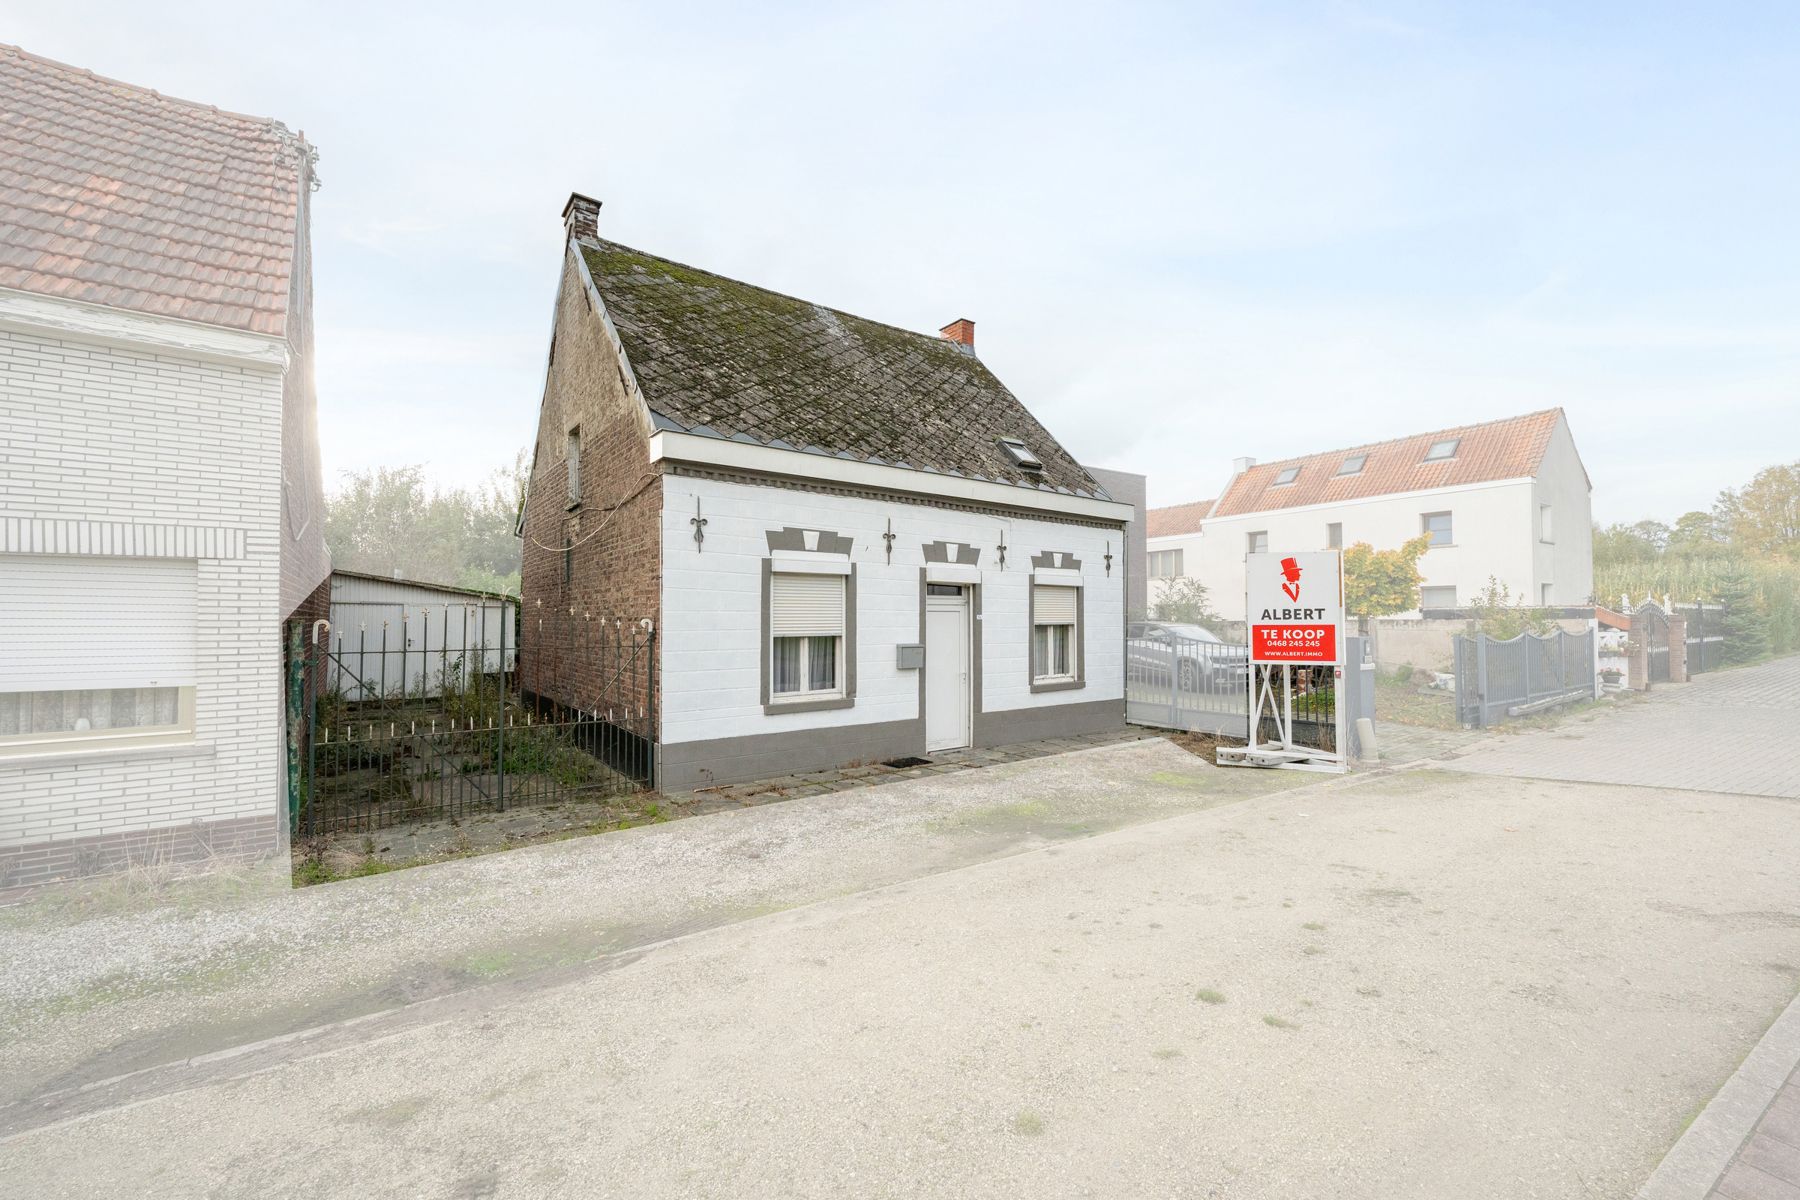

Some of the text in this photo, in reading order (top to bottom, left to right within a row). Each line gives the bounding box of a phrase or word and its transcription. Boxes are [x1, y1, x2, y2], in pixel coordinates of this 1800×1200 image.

[1261, 608, 1325, 620] ALBERT
[1261, 629, 1325, 639] TE KOOP
